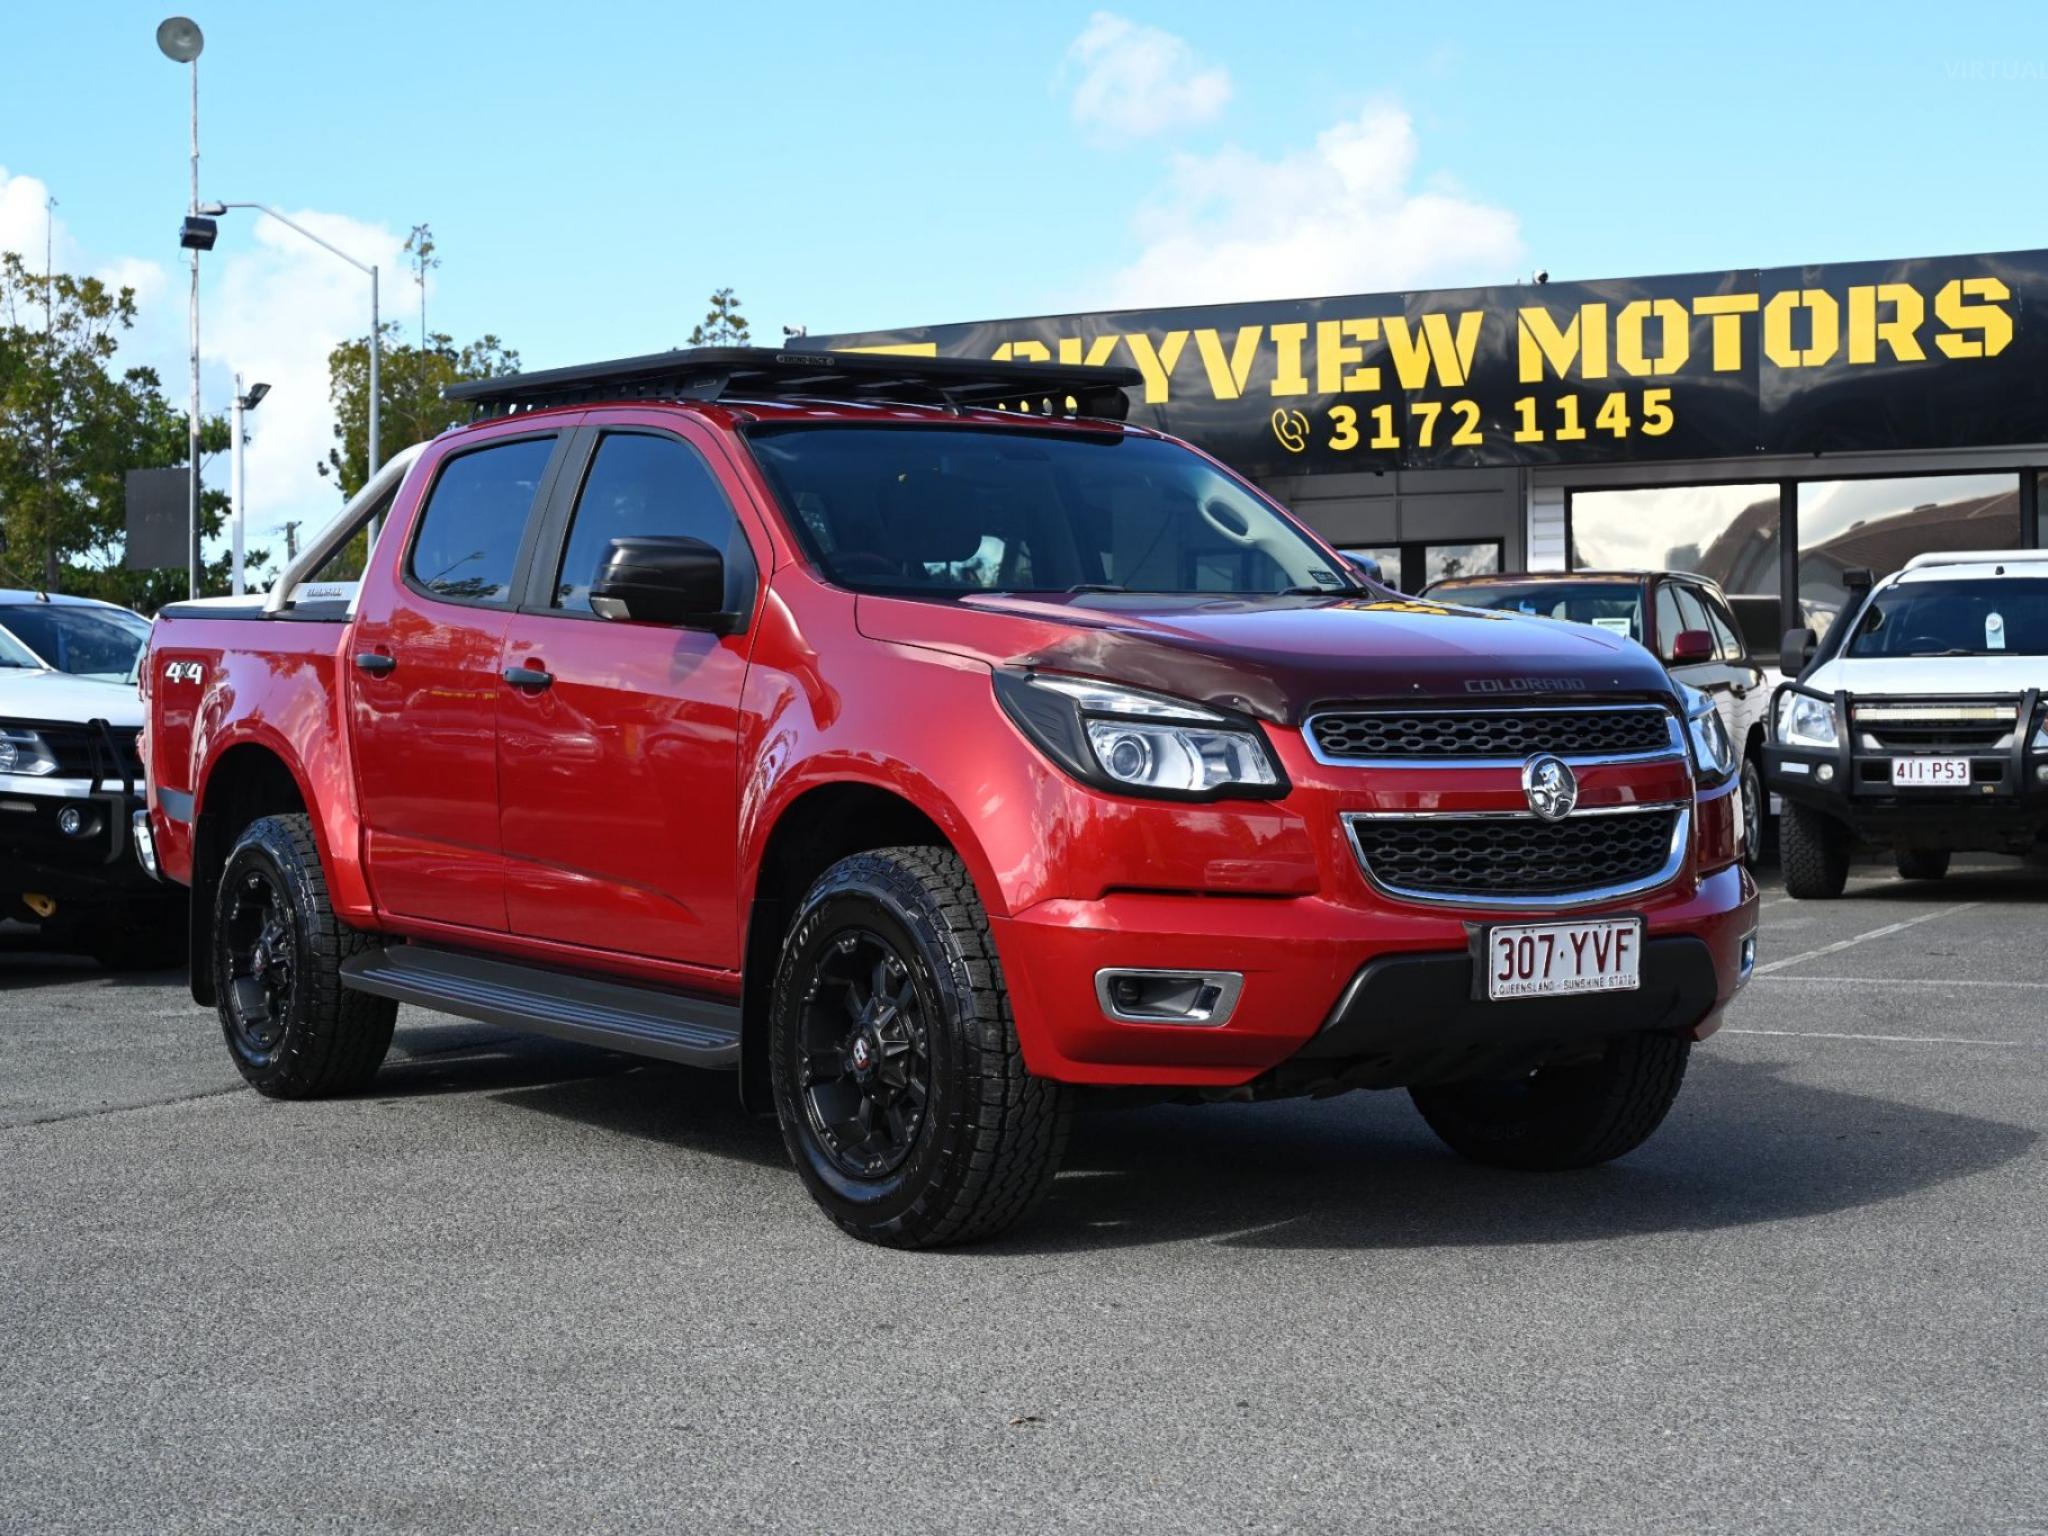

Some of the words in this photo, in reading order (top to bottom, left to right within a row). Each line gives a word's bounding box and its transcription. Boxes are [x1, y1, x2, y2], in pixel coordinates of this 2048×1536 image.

[1516, 277, 2014, 384] MOTORS
[1327, 399, 1483, 451] 3172
[1513, 388, 1675, 443] 1145
[1464, 678, 1586, 693] COLORADO
[1499, 981, 1554, 995] QUEENSLAND
[1563, 976, 1605, 990] SUNSHINE
[1608, 974, 1633, 988] STATE
